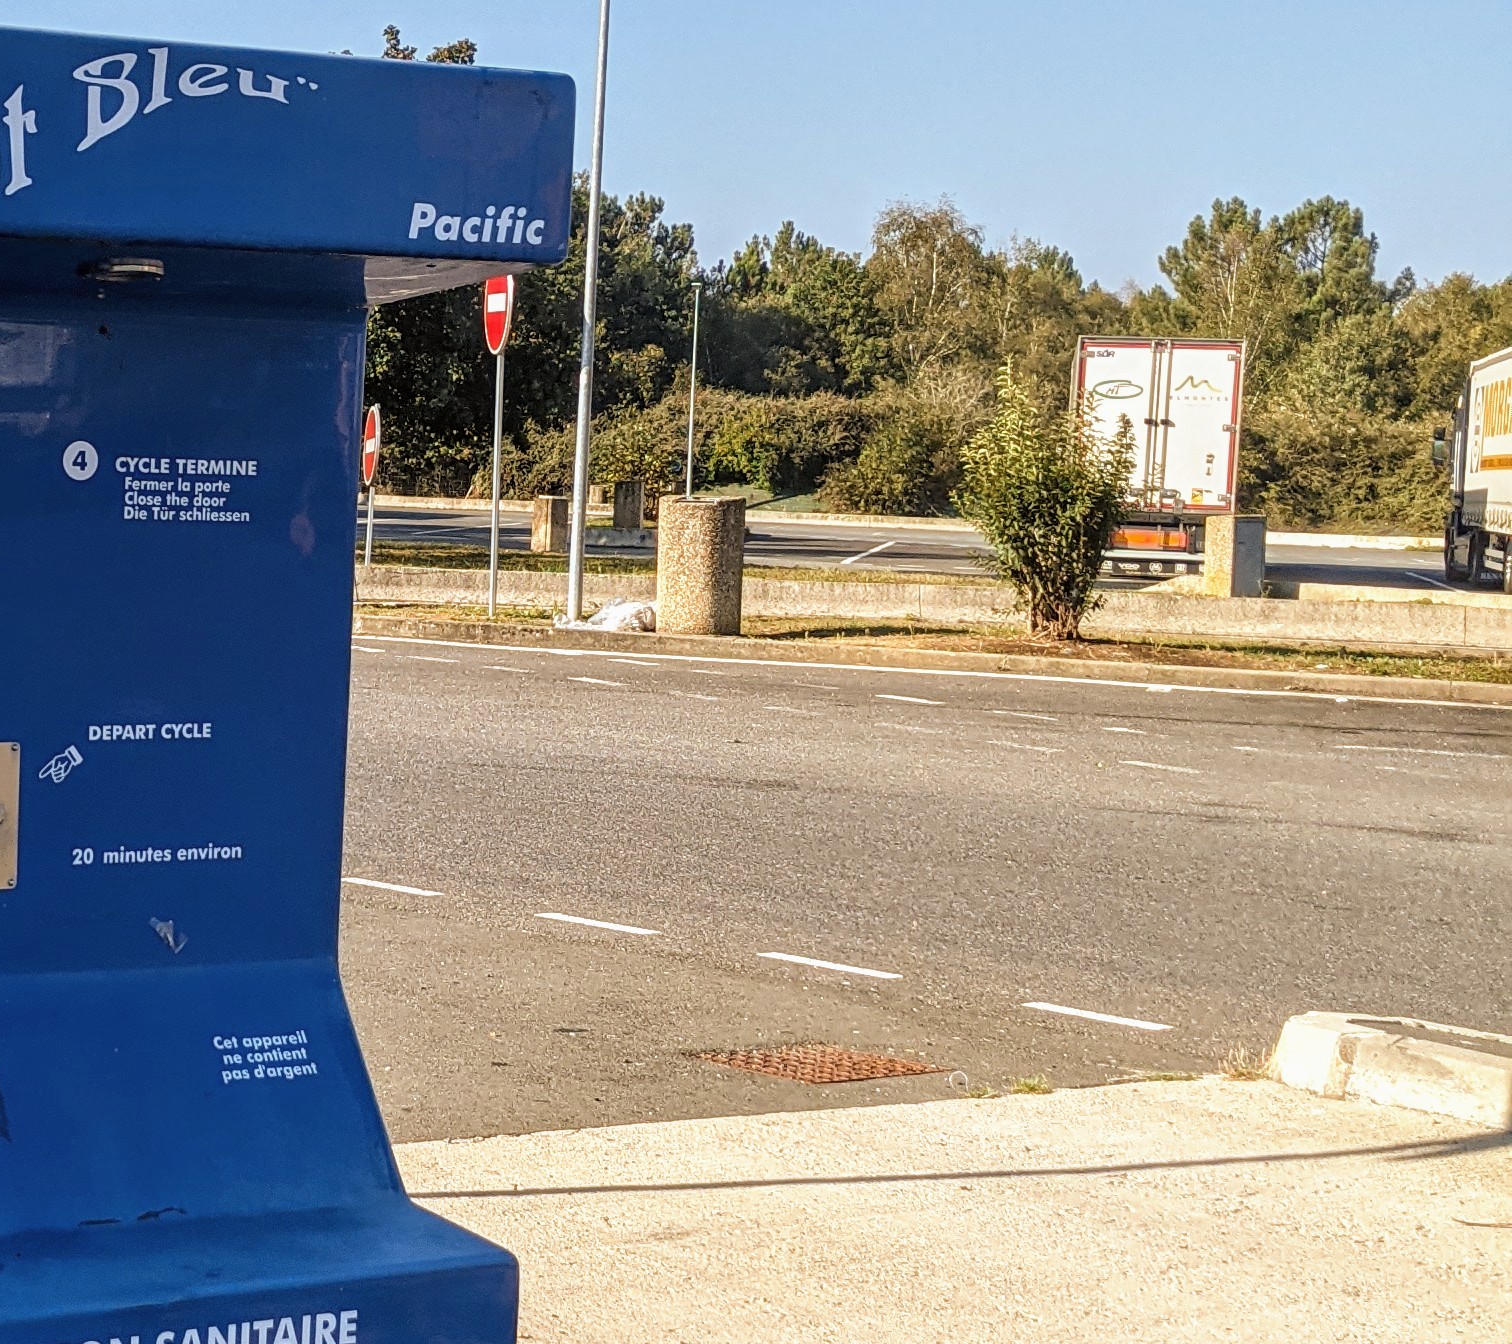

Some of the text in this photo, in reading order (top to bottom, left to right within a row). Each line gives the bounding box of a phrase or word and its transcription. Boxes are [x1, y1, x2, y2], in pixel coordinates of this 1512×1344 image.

[409, 203, 544, 244] Pacific
[116, 457, 170, 473] CYCLE
[176, 459, 257, 475] TERMINE
[125, 477, 230, 496] Fermer la porte
[125, 491, 226, 507] Close the door
[124, 506, 250, 522] Die Tür schliessen
[89, 723, 211, 740] DEPART CYCLE
[73, 843, 241, 864] 20 minutes environ
[213, 1030, 308, 1050] Cet appareil
[223, 1047, 308, 1064] ne contient
[222, 1062, 318, 1084] pas d'argent
